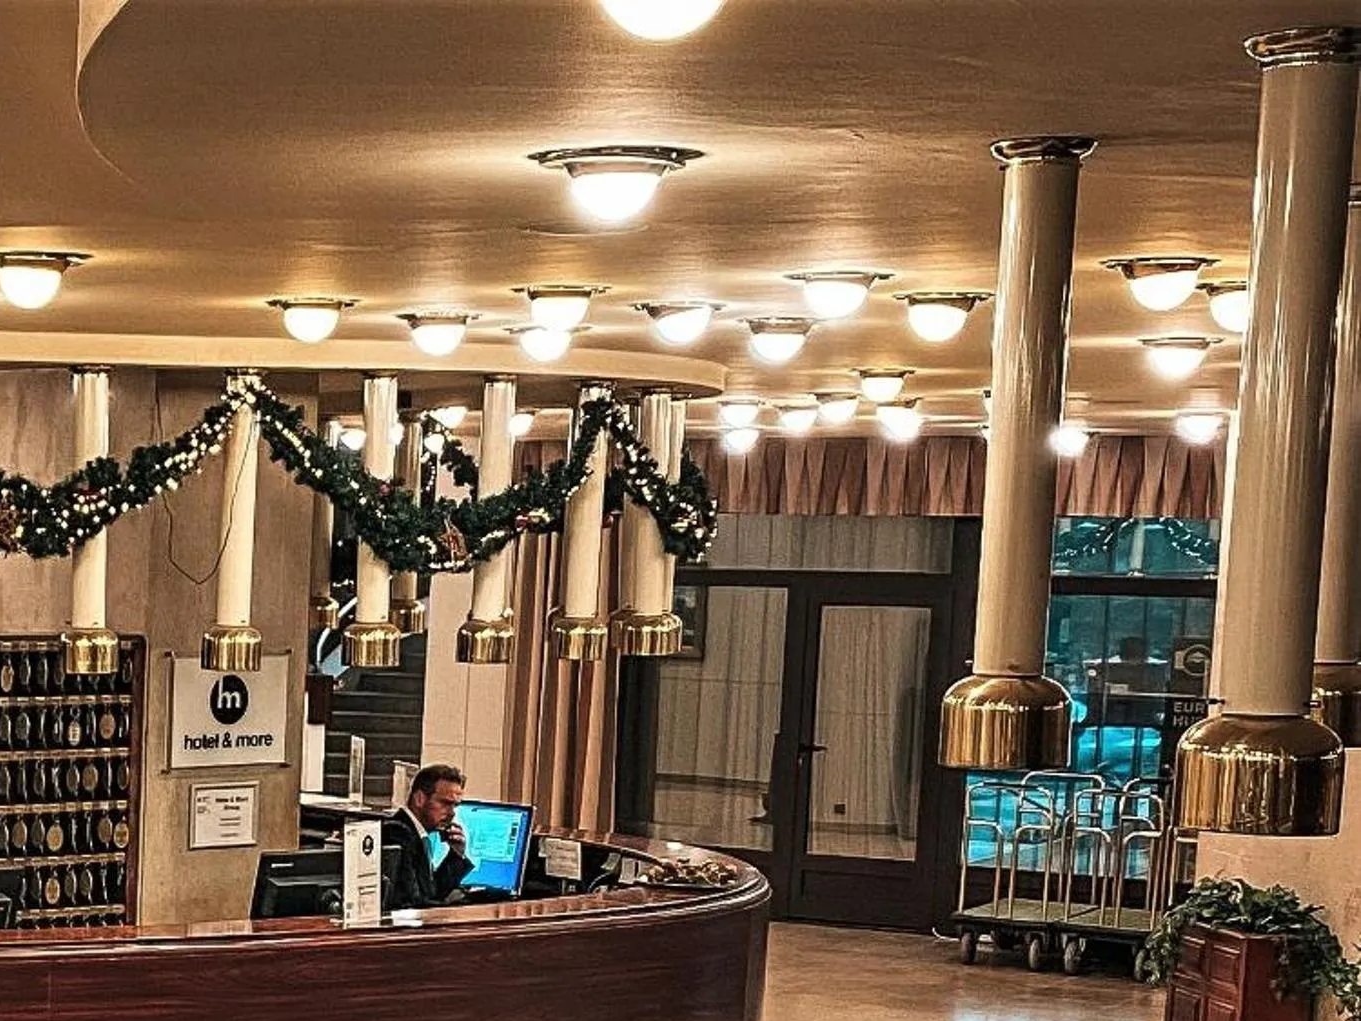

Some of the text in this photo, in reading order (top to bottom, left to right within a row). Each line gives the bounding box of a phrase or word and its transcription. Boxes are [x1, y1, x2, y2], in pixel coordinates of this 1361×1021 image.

[184, 731, 274, 751] hotel & more
